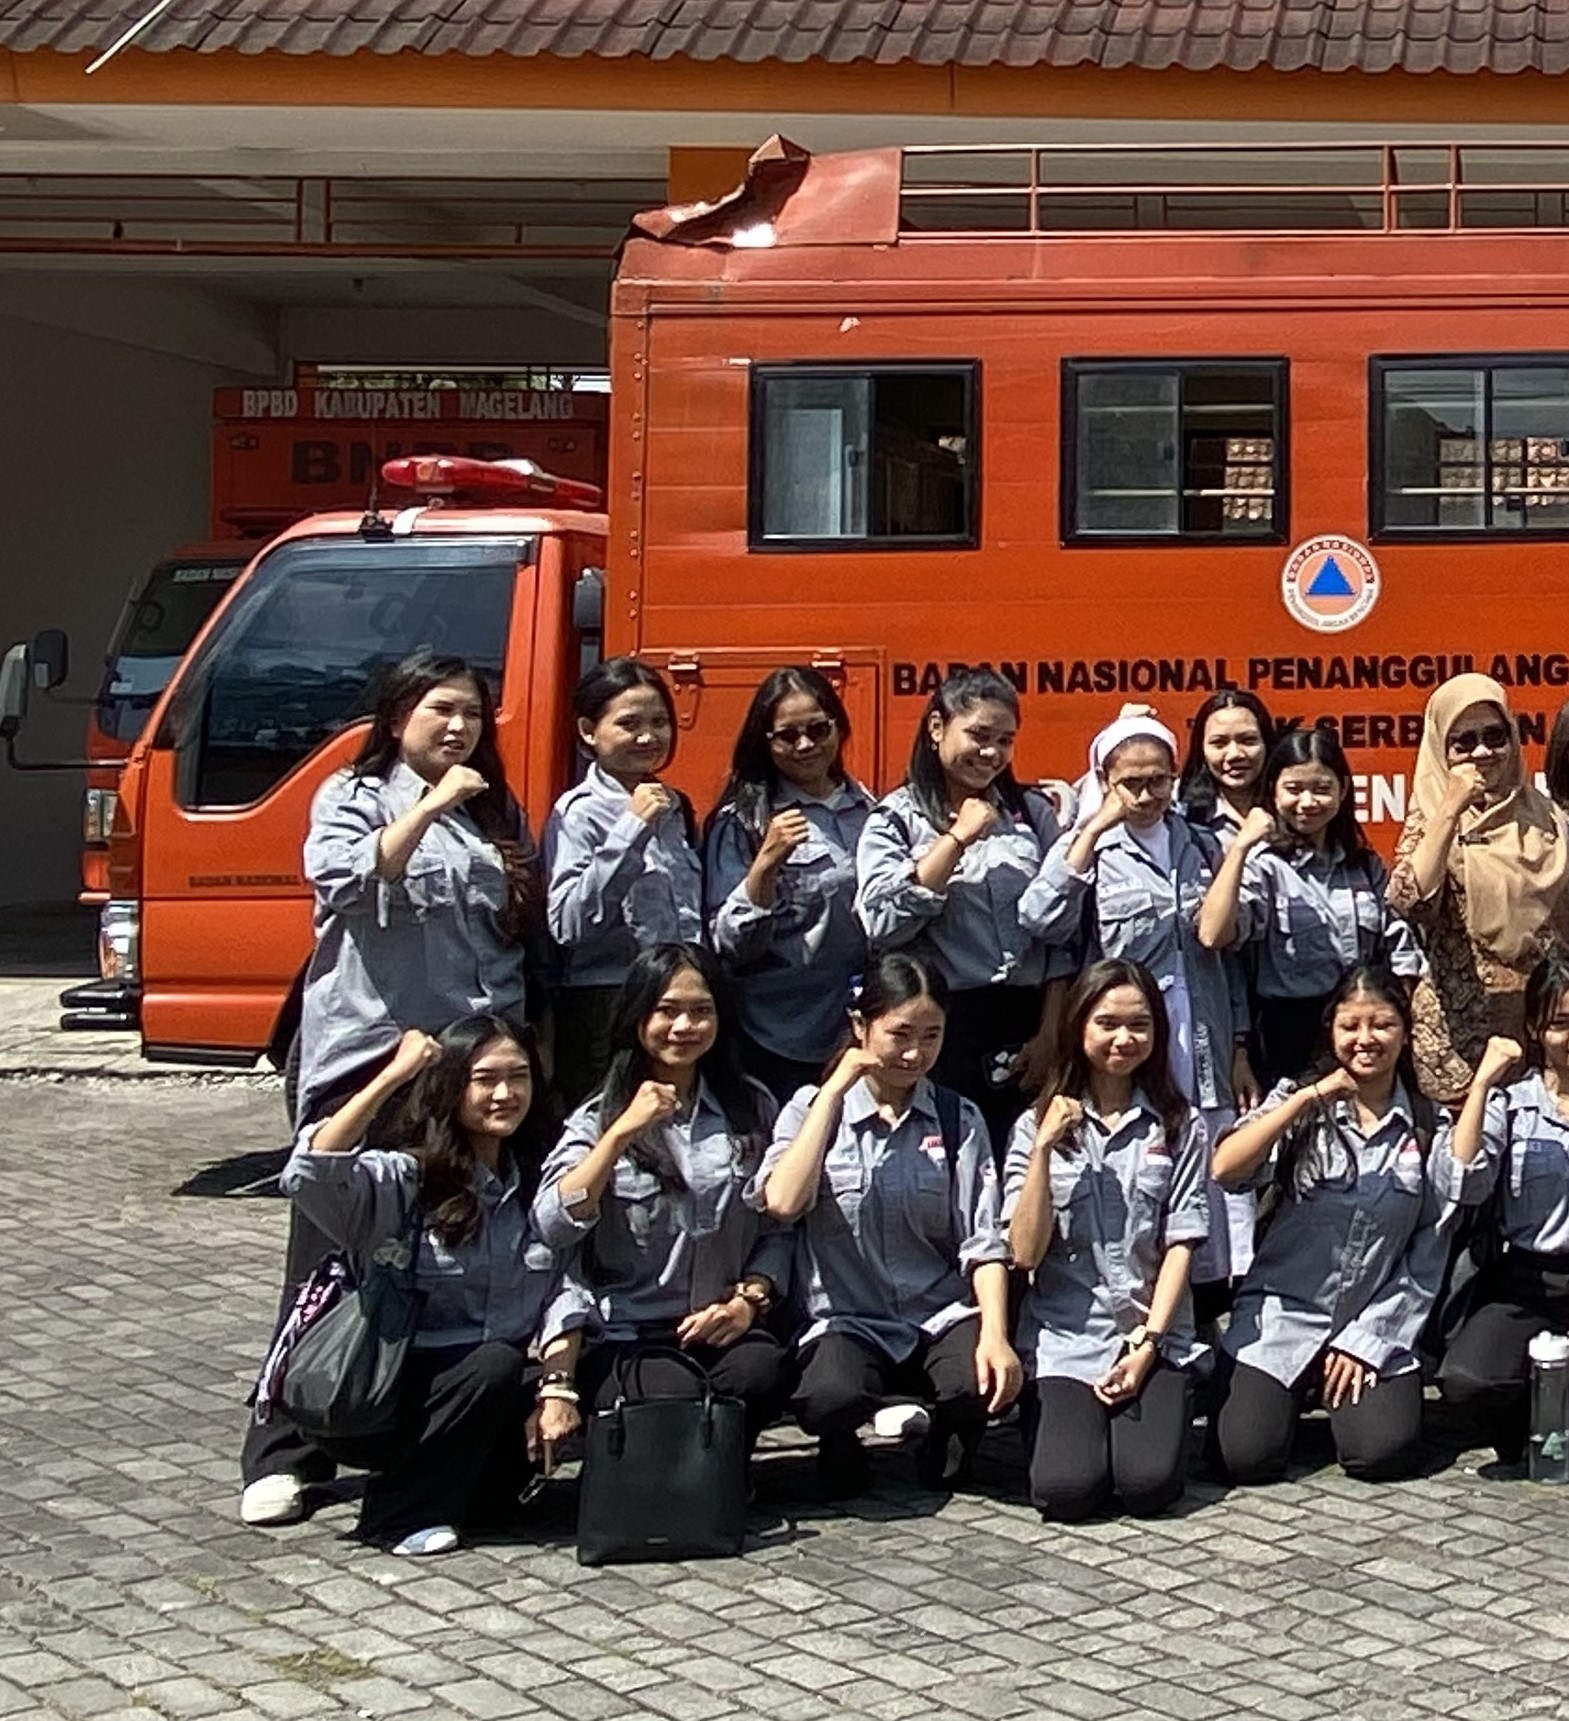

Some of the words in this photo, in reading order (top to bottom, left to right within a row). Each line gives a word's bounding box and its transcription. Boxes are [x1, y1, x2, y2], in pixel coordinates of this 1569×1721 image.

[243, 389, 298, 418] BPBD
[314, 390, 441, 419] KABUPATEN
[459, 391, 575, 420] MAGELANG
[893, 661, 1028, 696] BAN
[1036, 659, 1239, 694] NASIONAL
